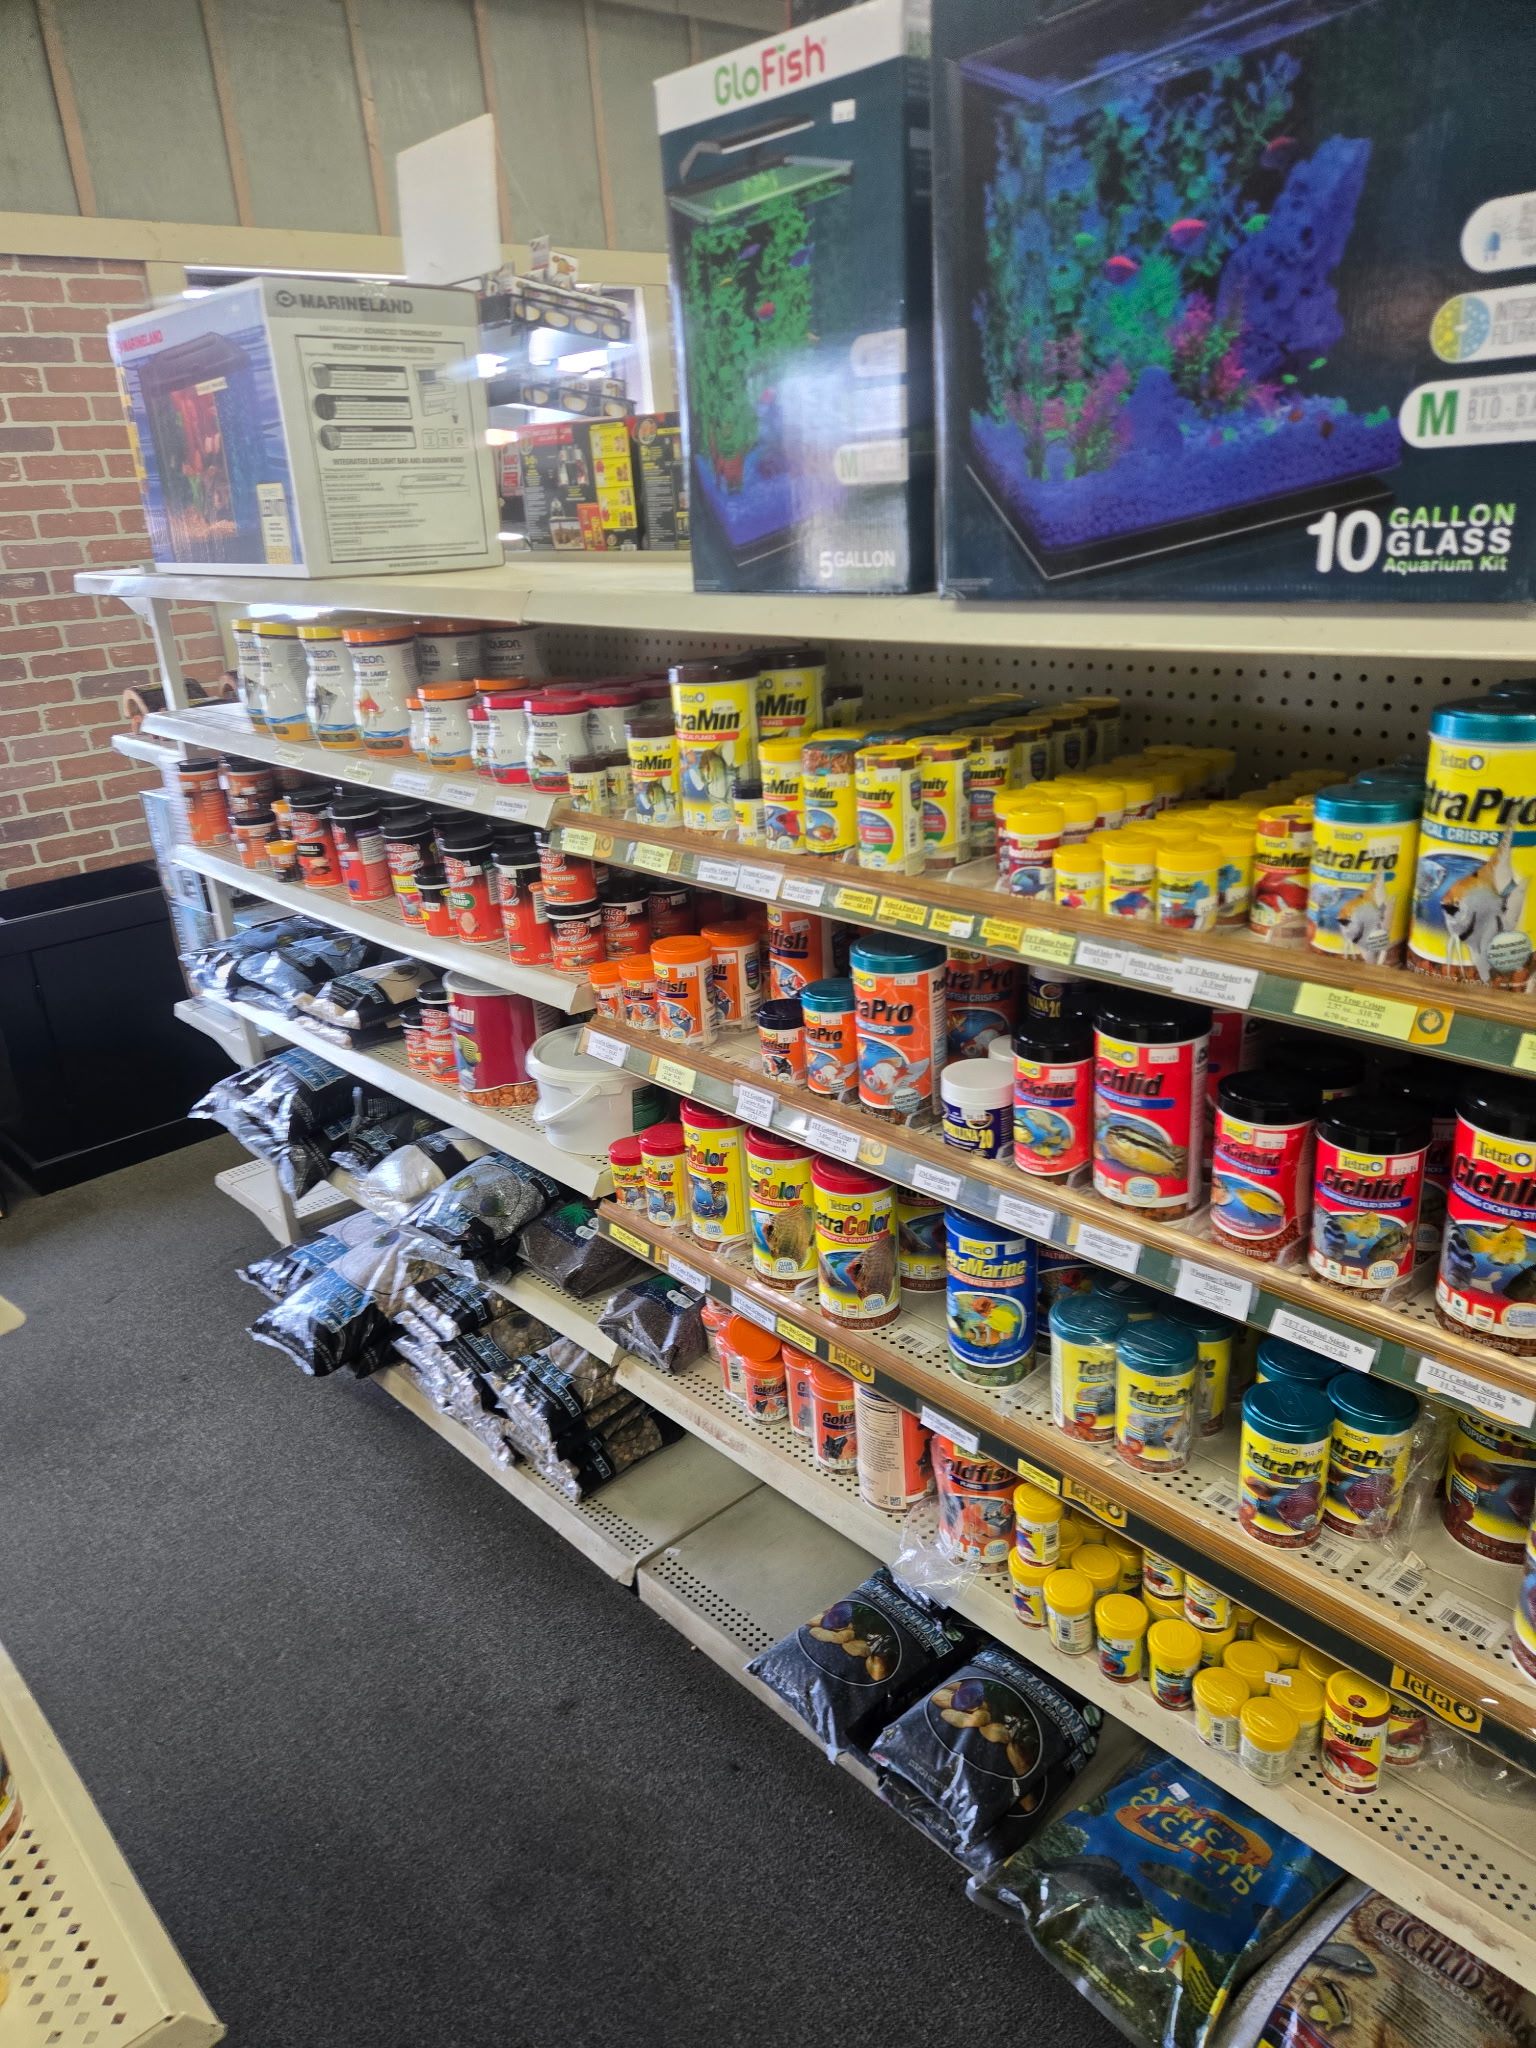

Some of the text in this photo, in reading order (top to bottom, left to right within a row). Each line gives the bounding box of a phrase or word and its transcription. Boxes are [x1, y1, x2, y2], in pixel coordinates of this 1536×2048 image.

[714, 36, 825, 106] GloFish
[300, 294, 414, 314] MARINELAND
[1417, 390, 1459, 437] M
[1306, 503, 1516, 573] 10 GALLON
[1386, 527, 1512, 556] GLASS
[818, 551, 895, 579] 5 GALLON
[1382, 555, 1508, 576] Aquarium Kit
[1440, 750, 1468, 769] Tetra
[1446, 827, 1499, 845] CRISPS
[1221, 973, 1242, 983] Select
[1362, 1000, 1386, 1012] Crisps
[978, 1129, 994, 1149] 20
[1477, 1140, 1513, 1165] Tetra
[1342, 1156, 1370, 1173] Tetra
[1324, 1165, 1408, 1198] Cichlid
[830, 1200, 851, 1212] Tetra
[1483, 1201, 1521, 1218] CICHLID
[848, 1234, 880, 1244] GRANULES
[1282, 1317, 1363, 1354] TET Cichlid Sticks 96
[833, 1346, 860, 1374] Tetra
[1427, 1366, 1521, 1406] TET Cichlid Sticks 96
[1459, 1418, 1498, 1450] TROPICAL
[1071, 1480, 1108, 1512] Tetra
[907, 1622, 931, 1650] GRAVEL
[1401, 1670, 1453, 1712] Tetra
[1044, 1705, 1070, 1738] GRAVEL
